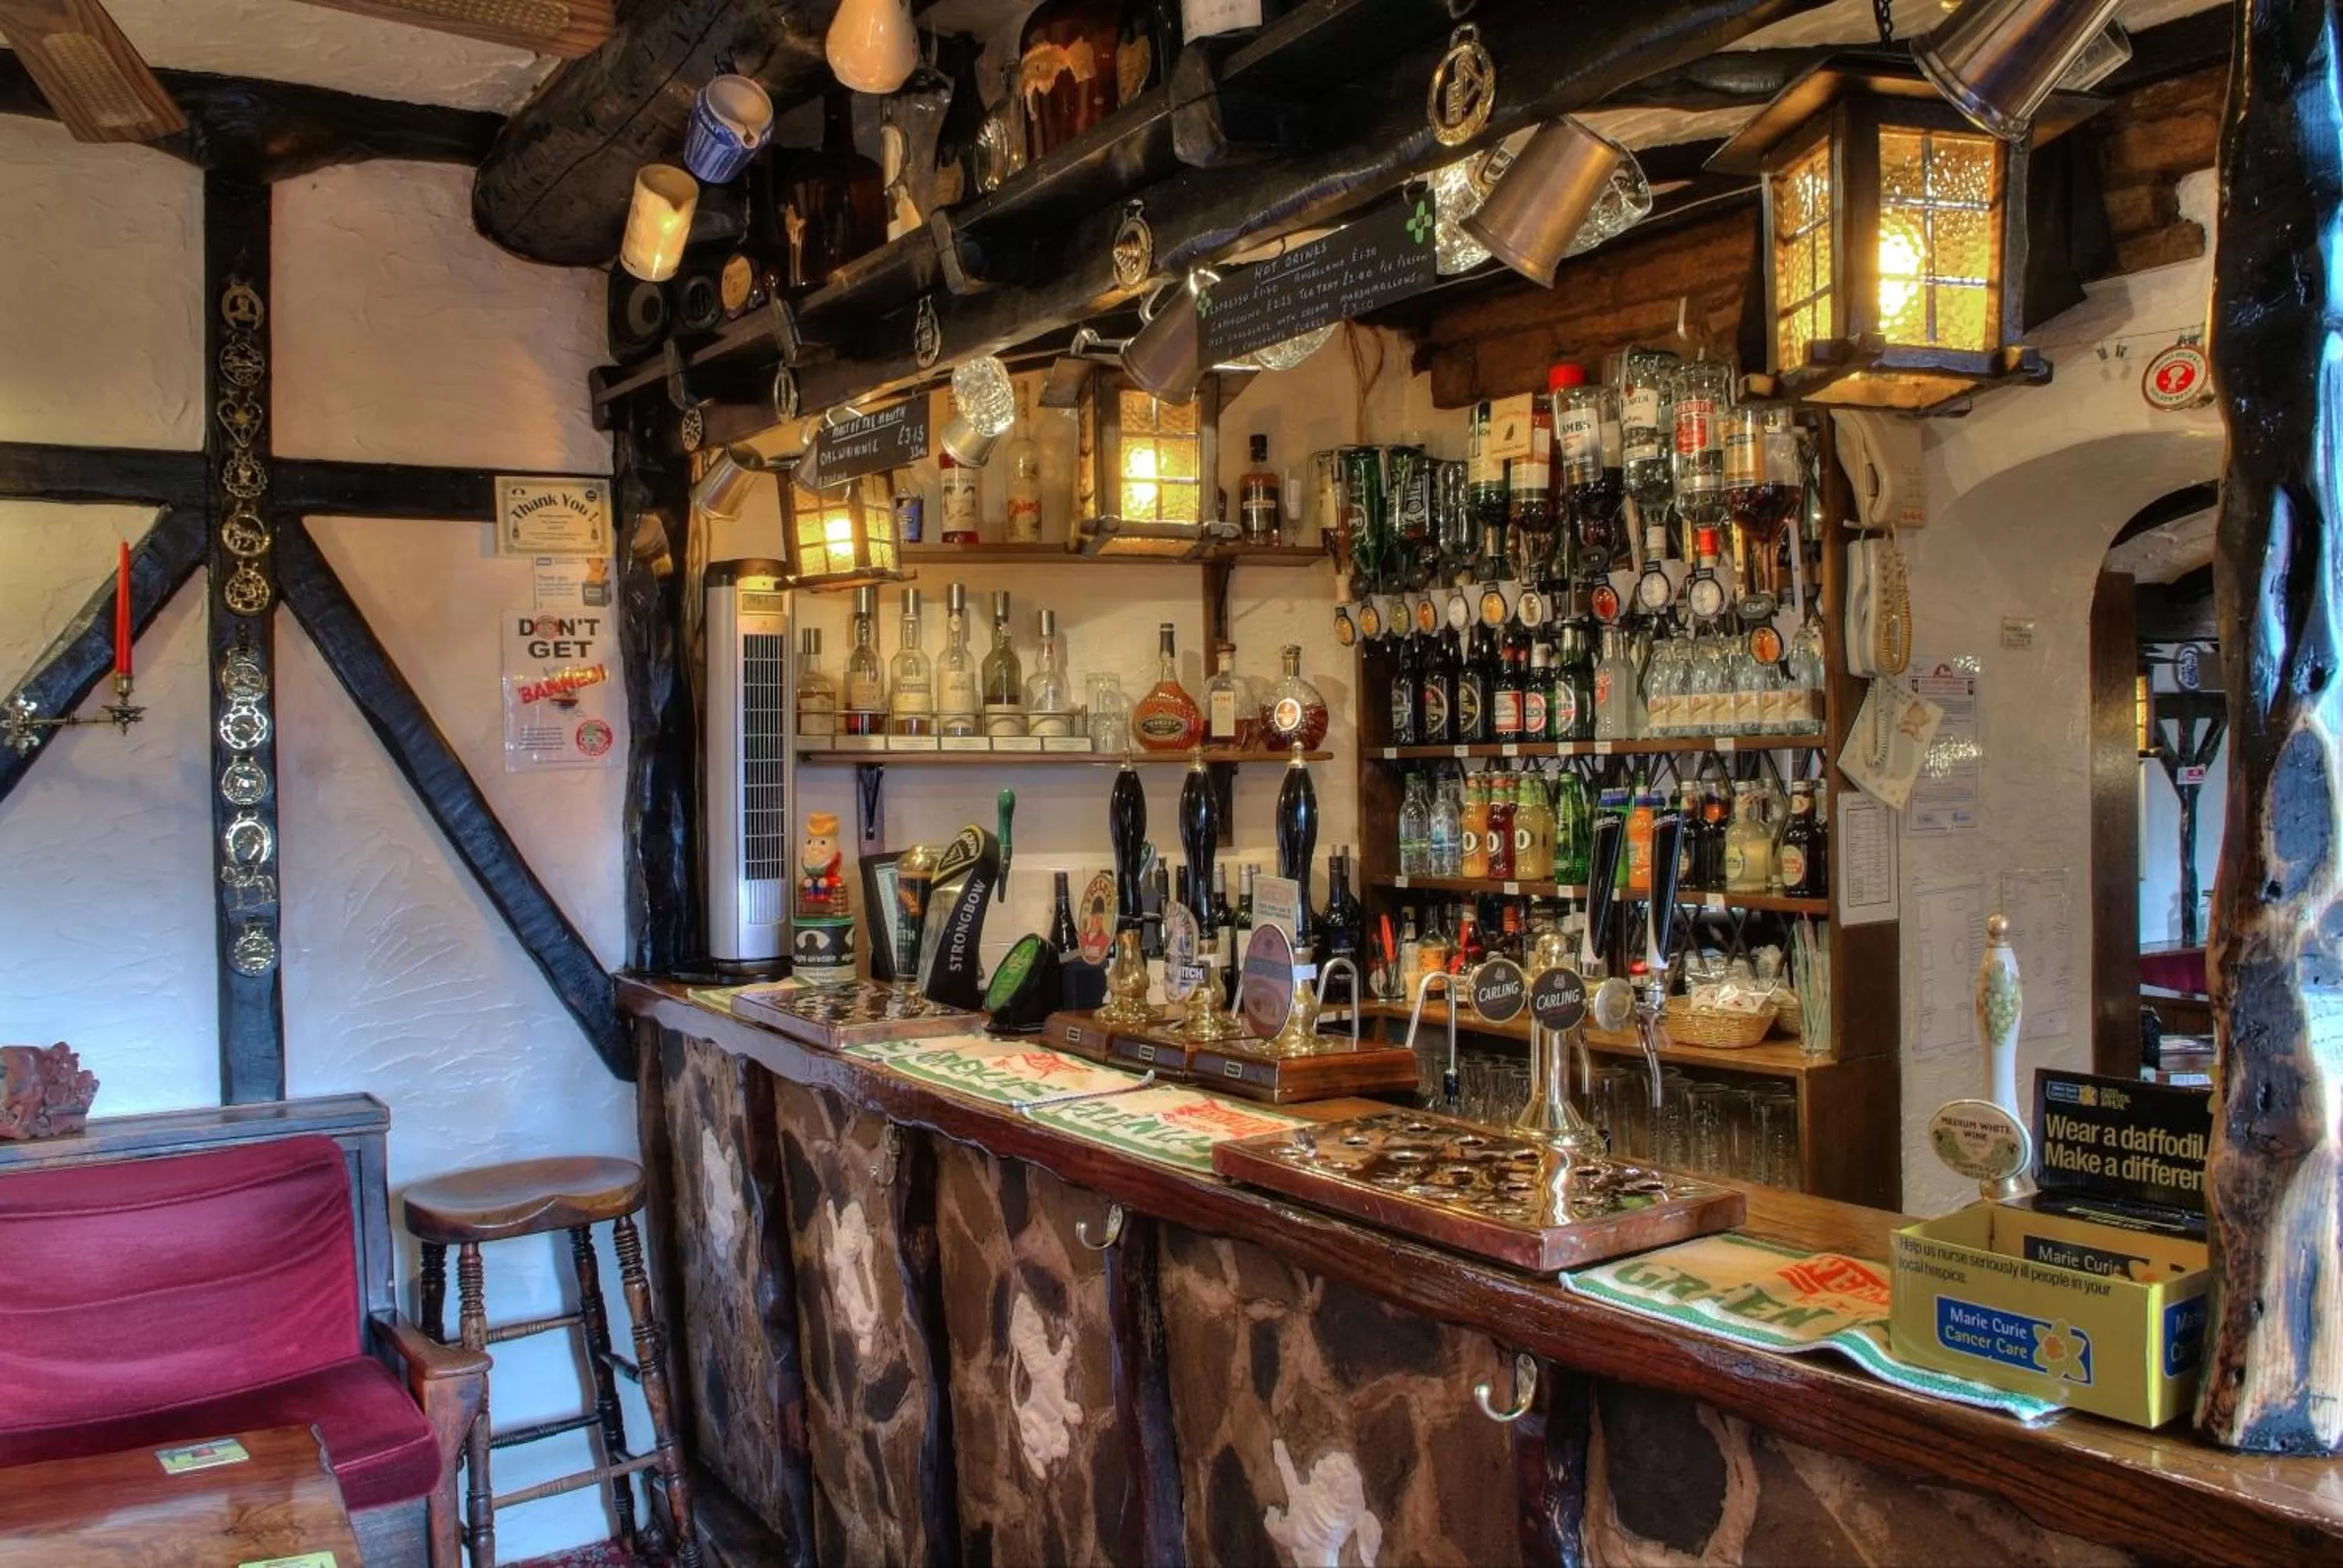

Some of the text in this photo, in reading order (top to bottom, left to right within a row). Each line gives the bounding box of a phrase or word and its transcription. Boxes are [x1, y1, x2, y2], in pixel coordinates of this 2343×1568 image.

[1255, 242, 1327, 279] HOT DRINKS
[511, 494, 558, 519] Thank
[528, 641, 594, 658] GET
[950, 879, 986, 972] STRONGBOW
[1478, 981, 1519, 1002] CARLING
[1536, 988, 1580, 1010] CARLING
[1941, 1116, 2012, 1135] MEDIUM WHITE
[1963, 1130, 1987, 1141] WINE
[2046, 1114, 2207, 1160] Wear a daffodil.
[2045, 1142, 2102, 1174] Make
[2105, 1156, 2118, 1178] a
[1899, 1256, 1923, 1273] local
[1899, 1236, 2112, 1297] Help us nurse seriously ill people in your
[2039, 1245, 2121, 1275] Marie Curie
[1950, 1306, 2027, 1340] Marie Curie
[1945, 1324, 2028, 1359] Cancer Care
